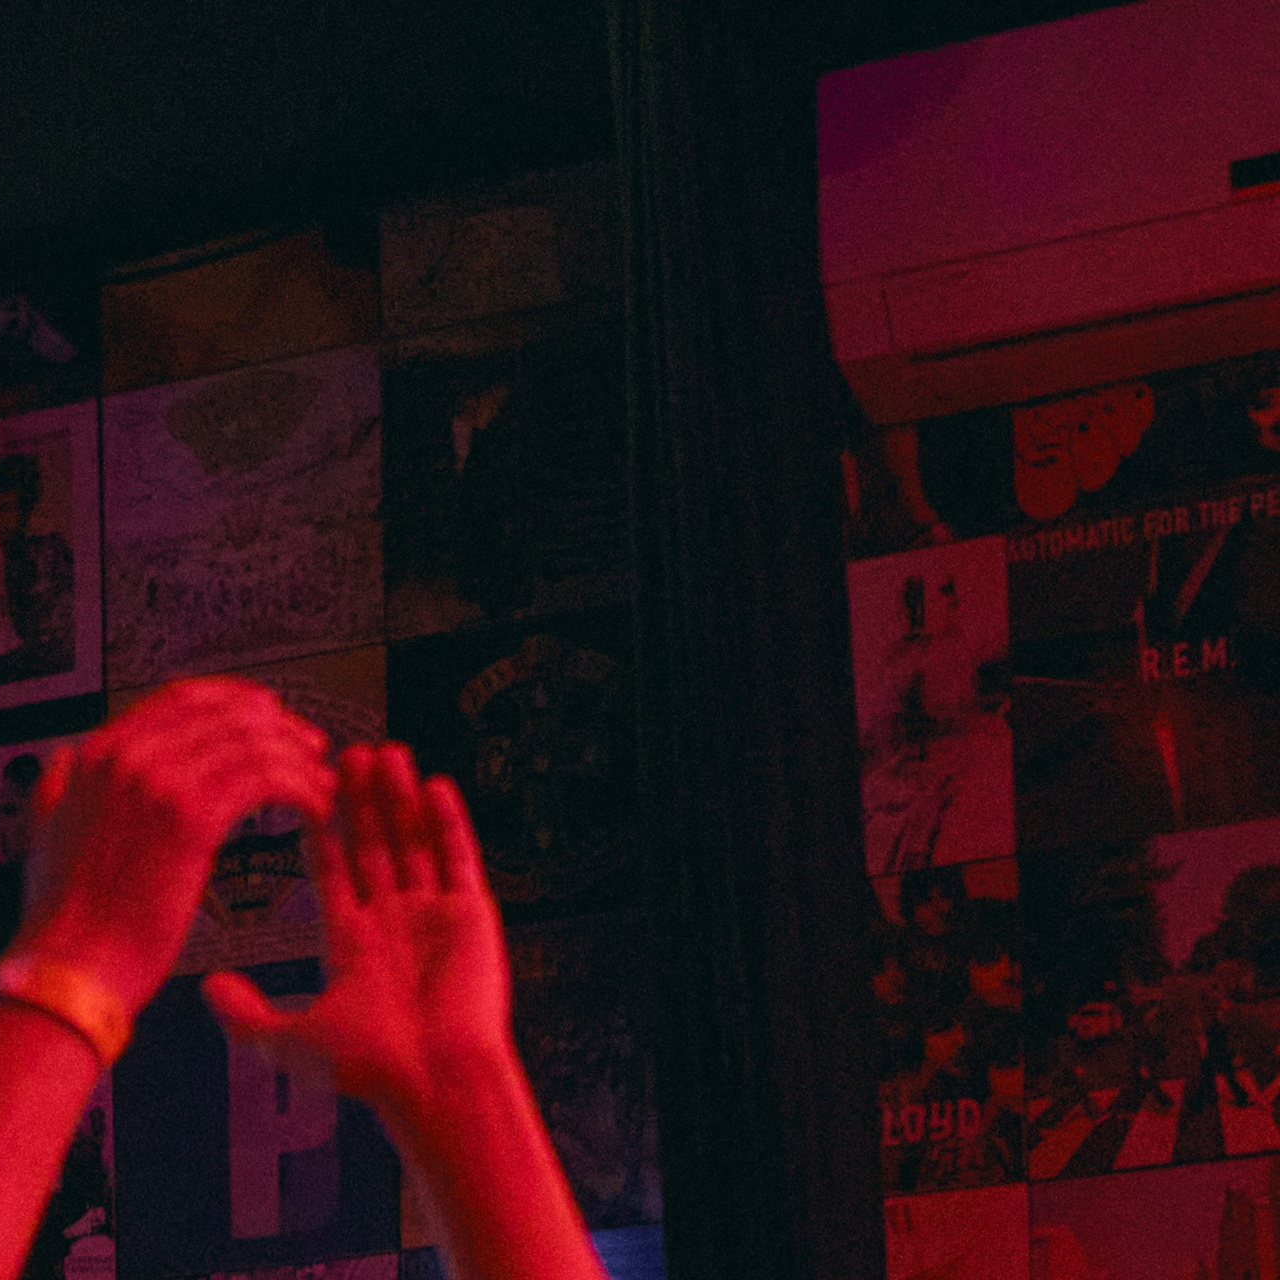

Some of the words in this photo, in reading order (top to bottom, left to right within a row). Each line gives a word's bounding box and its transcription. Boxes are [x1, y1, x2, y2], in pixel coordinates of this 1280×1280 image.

[1007, 516, 1134, 563] AUTOMATIC
[1143, 506, 1190, 539] FOR
[1197, 495, 1242, 529] THE
